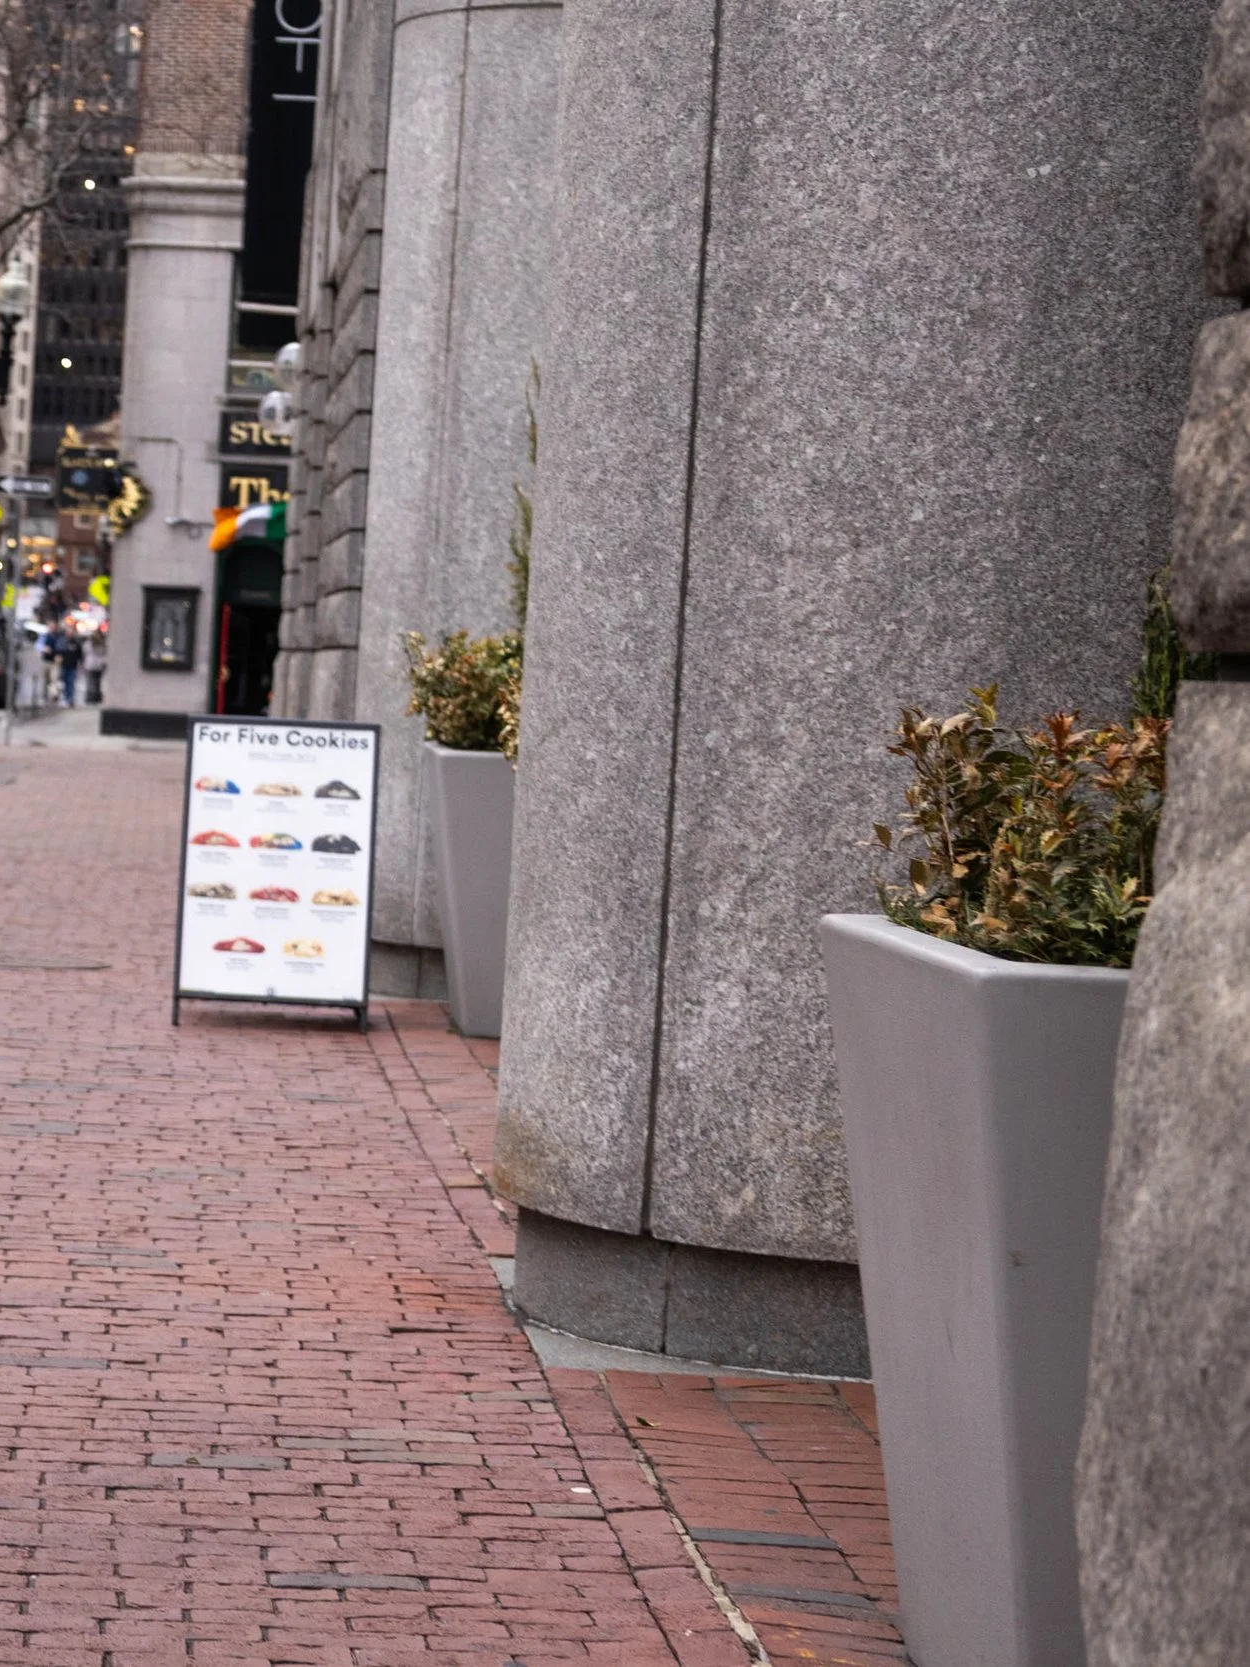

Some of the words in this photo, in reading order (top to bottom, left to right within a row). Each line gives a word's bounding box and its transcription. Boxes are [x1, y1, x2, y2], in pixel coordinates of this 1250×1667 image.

[198, 726, 230, 743] For
[237, 728, 279, 746] Five
[285, 730, 369, 750] Cookies
